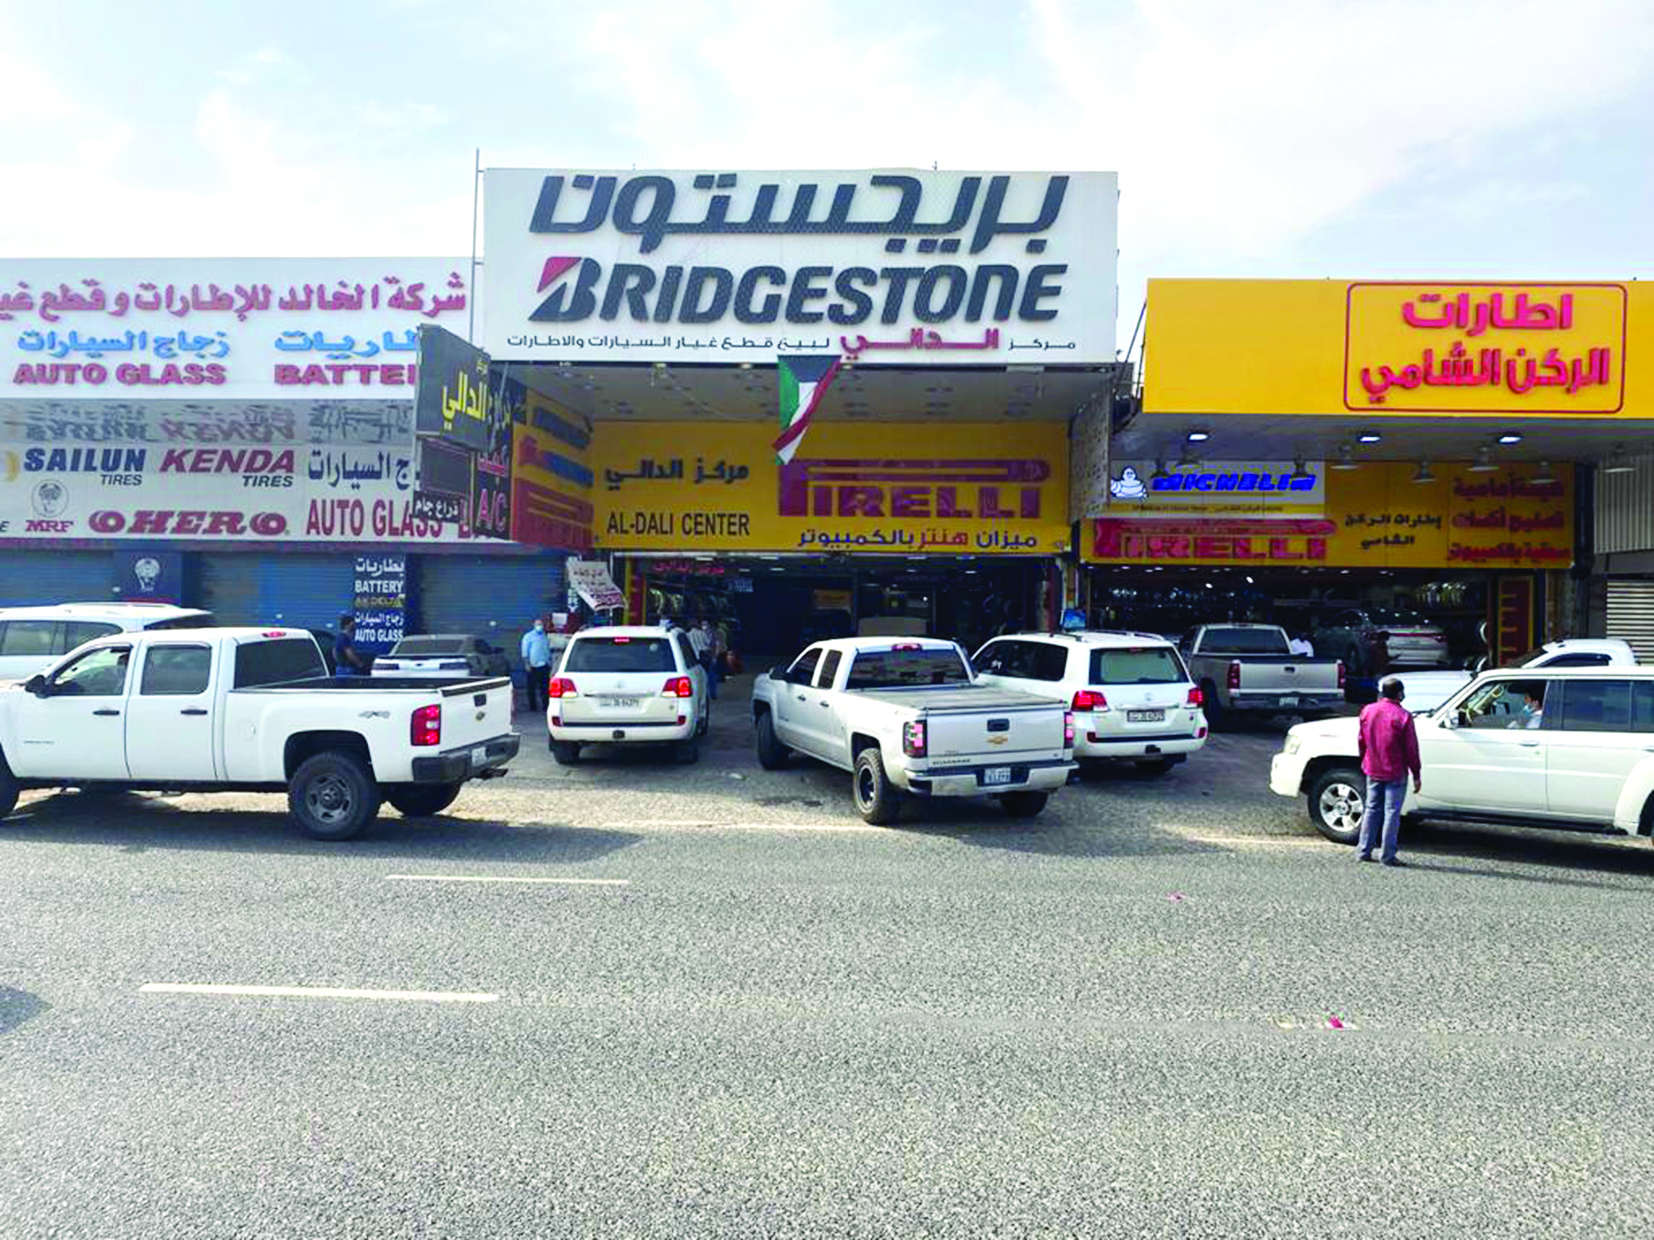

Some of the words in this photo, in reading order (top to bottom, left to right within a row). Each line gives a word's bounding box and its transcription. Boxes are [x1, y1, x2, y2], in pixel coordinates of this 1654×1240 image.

[529, 173, 1070, 255] بريجستون
[39, 278, 106, 322] قطع
[278, 281, 379, 310] الخالد
[383, 272, 466, 318] شركة
[528, 256, 1068, 325] BRIDGESTONE
[1402, 292, 1573, 337] اطارات
[17, 329, 148, 359] السيارات
[153, 330, 230, 359] زجاج
[587, 336, 671, 349] السيارات
[675, 336, 717, 349] غيار
[721, 336, 773, 350] قطع
[840, 328, 999, 361] الدالي
[1008, 337, 1076, 350] مركز
[13, 363, 108, 385] AUTO
[115, 363, 227, 386] GLASS
[1361, 341, 1501, 404] الشامي
[1506, 347, 1611, 395] الركن
[24, 448, 146, 472] SAILUN
[159, 449, 295, 473] KENDA
[694, 457, 751, 484] مركز
[100, 474, 142, 486] TIRES
[242, 475, 293, 487] TIRES
[605, 458, 683, 491] الدالي
[778, 458, 1050, 518] PIRELLI
[25, 520, 74, 532] MRF
[306, 499, 365, 536] AUTO
[607, 512, 674, 535] AL-DALI
[681, 512, 750, 536] CENTER
[976, 528, 1038, 549] ميزان
[1095, 517, 1338, 559] PIRELLI
[355, 558, 405, 577] بطاريات
[355, 580, 403, 593] BATTERY
[355, 629, 376, 642] AUTO
[377, 629, 404, 642] GLASS
